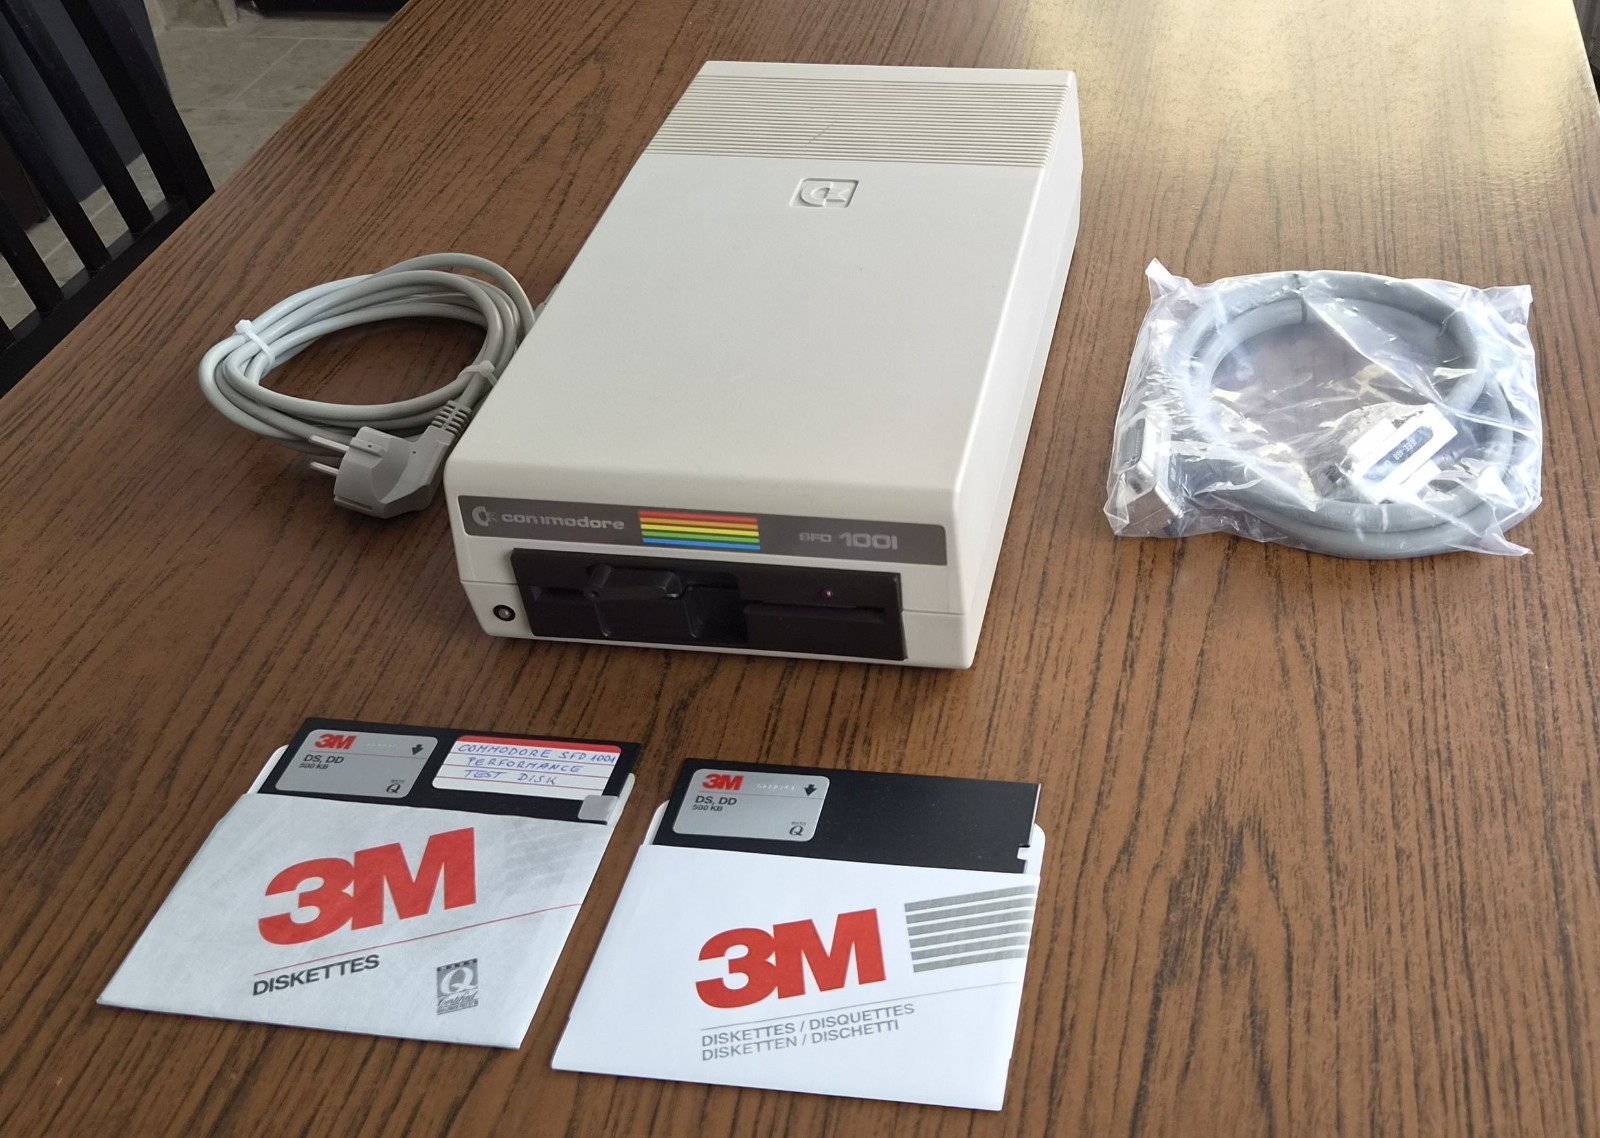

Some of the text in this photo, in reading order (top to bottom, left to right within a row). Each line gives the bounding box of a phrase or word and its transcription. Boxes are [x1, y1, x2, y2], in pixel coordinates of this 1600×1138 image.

[501, 512, 625, 530] commodore
[838, 532, 899, 550] 1001
[314, 733, 357, 750] 3M
[303, 754, 345, 764] DS, DD
[458, 743, 550, 759] COMMODORE
[589, 753, 617, 764] 1001
[467, 756, 584, 773] PERFORMANCE
[464, 769, 559, 785] TEST DISK
[702, 773, 745, 791] 3M
[695, 795, 738, 806] DS, DD
[710, 804, 724, 812] KB
[258, 827, 477, 945] 3M
[695, 908, 887, 1008] 3M
[252, 953, 381, 997] DISKETTES
[701, 1022, 796, 1047] DISKETTES
[809, 1003, 916, 1031] DISQUETTES
[702, 1036, 798, 1062] DISKETTEN
[811, 1019, 900, 1044] DISCHETTI
